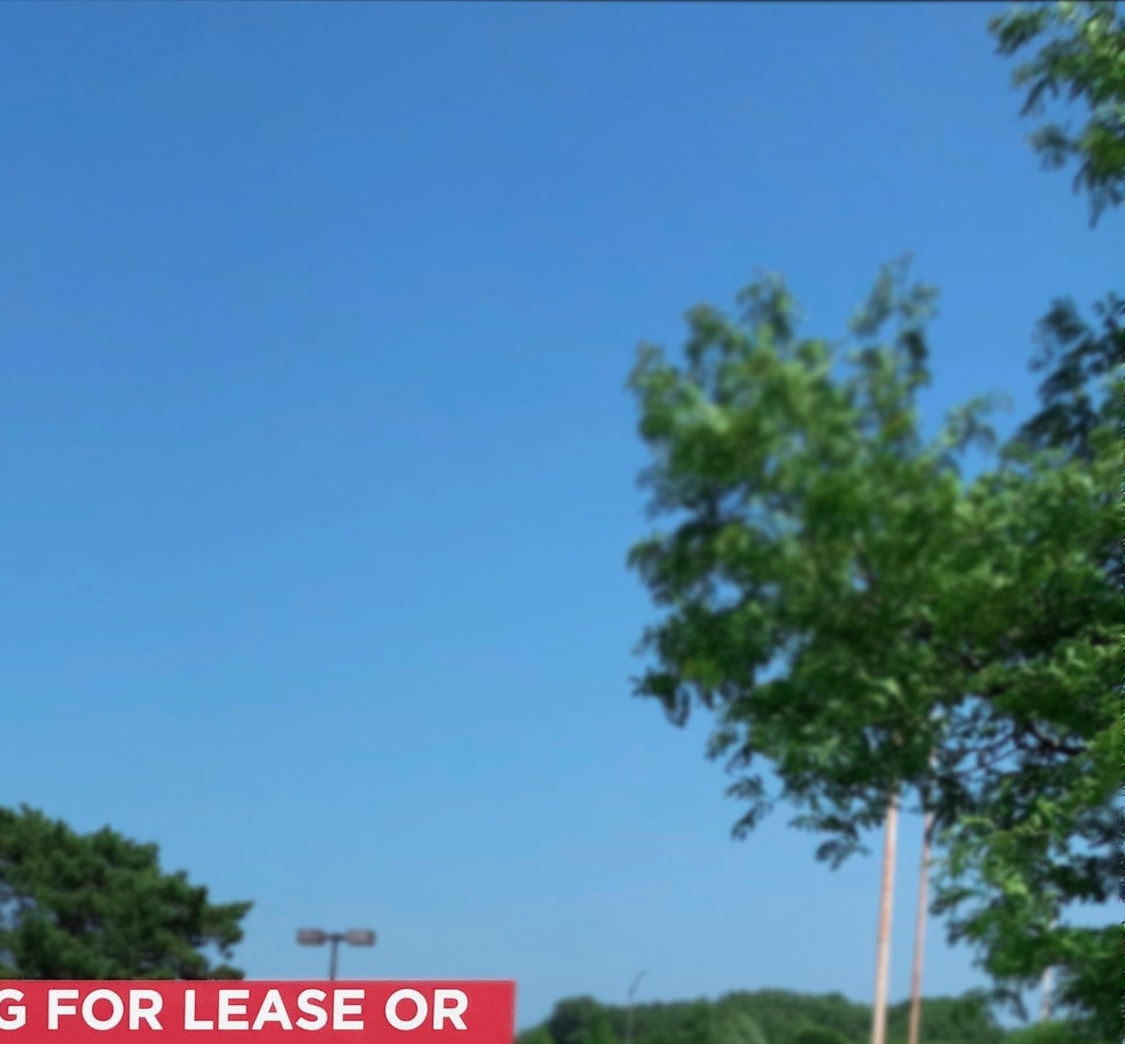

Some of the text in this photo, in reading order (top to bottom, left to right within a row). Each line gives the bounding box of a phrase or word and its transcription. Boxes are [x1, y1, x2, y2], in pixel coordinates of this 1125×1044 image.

[47, 988, 164, 1031] FOR
[184, 988, 366, 1031] LEASE
[384, 988, 469, 1031] OR
